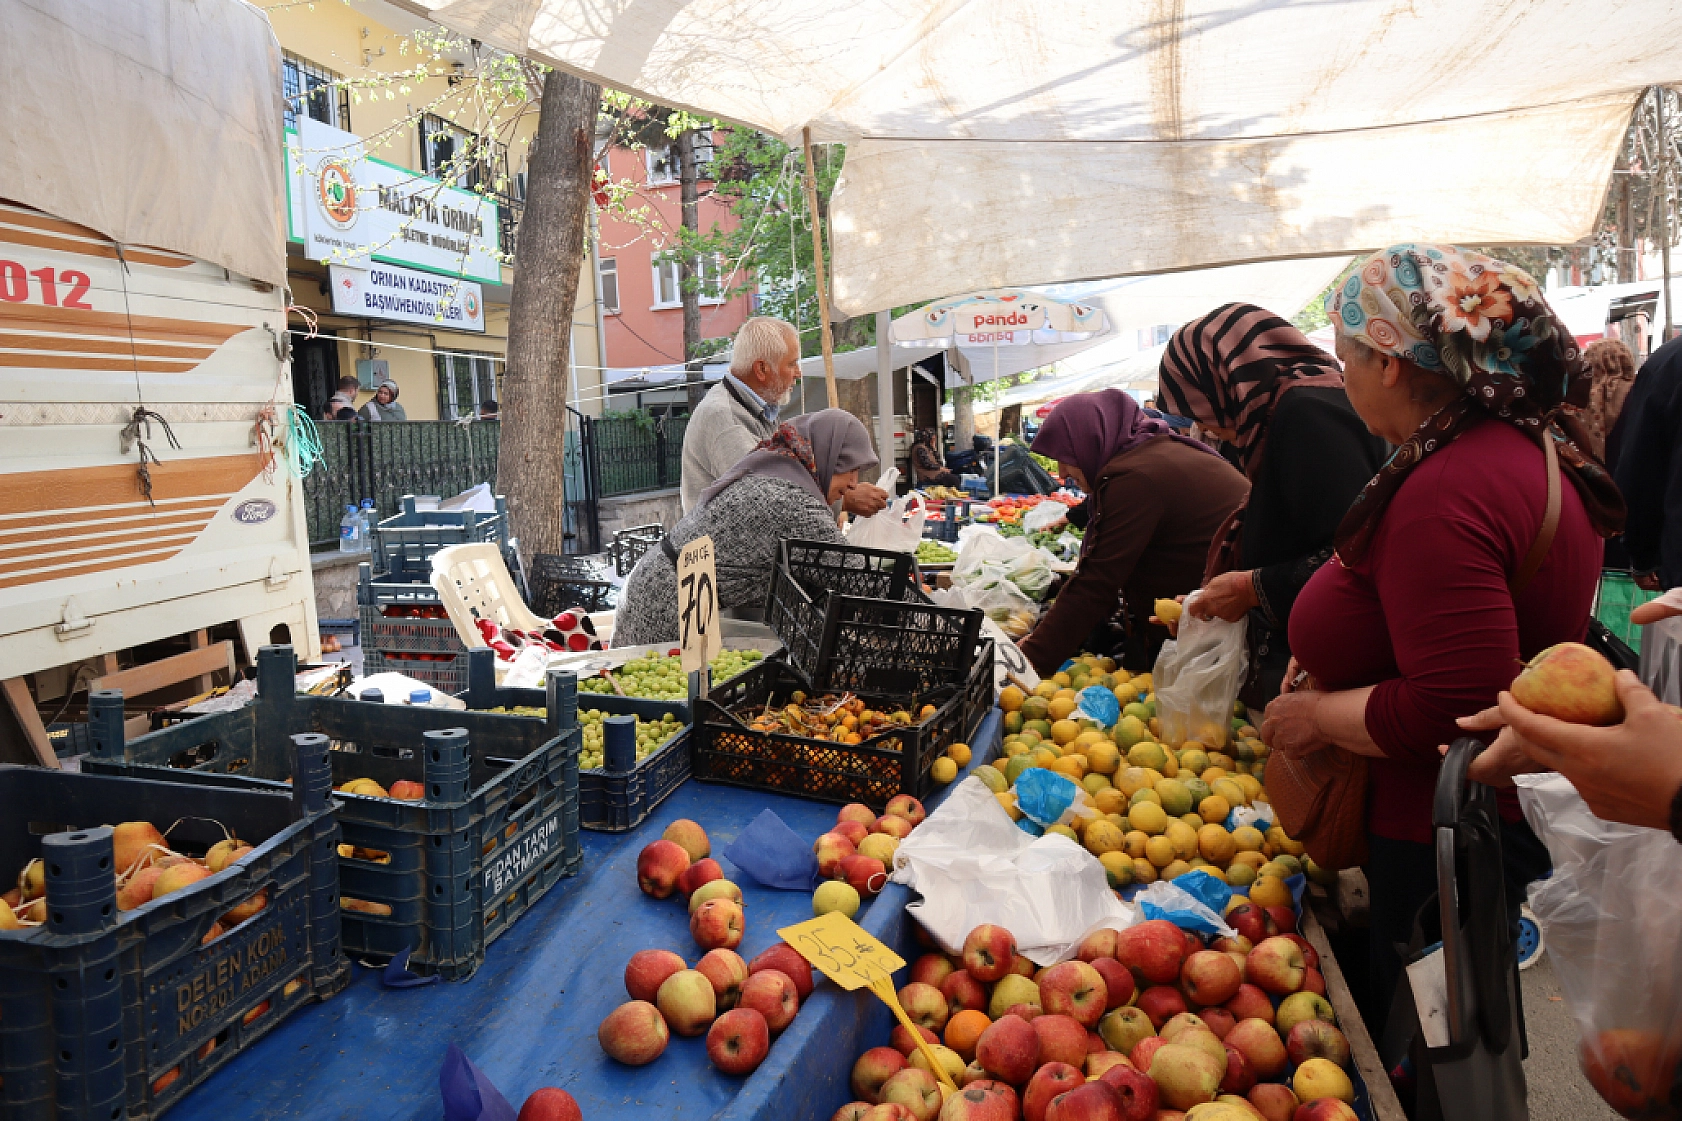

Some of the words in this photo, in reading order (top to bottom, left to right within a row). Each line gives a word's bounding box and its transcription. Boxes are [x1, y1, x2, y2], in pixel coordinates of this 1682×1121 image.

[371, 270, 406, 290] ORMAN
[974, 312, 1028, 328] panda
[681, 572, 713, 650] 70
[523, 816, 558, 854] TARIM
[494, 838, 548, 894] BATMAN
[178, 951, 242, 1012] DELEN
